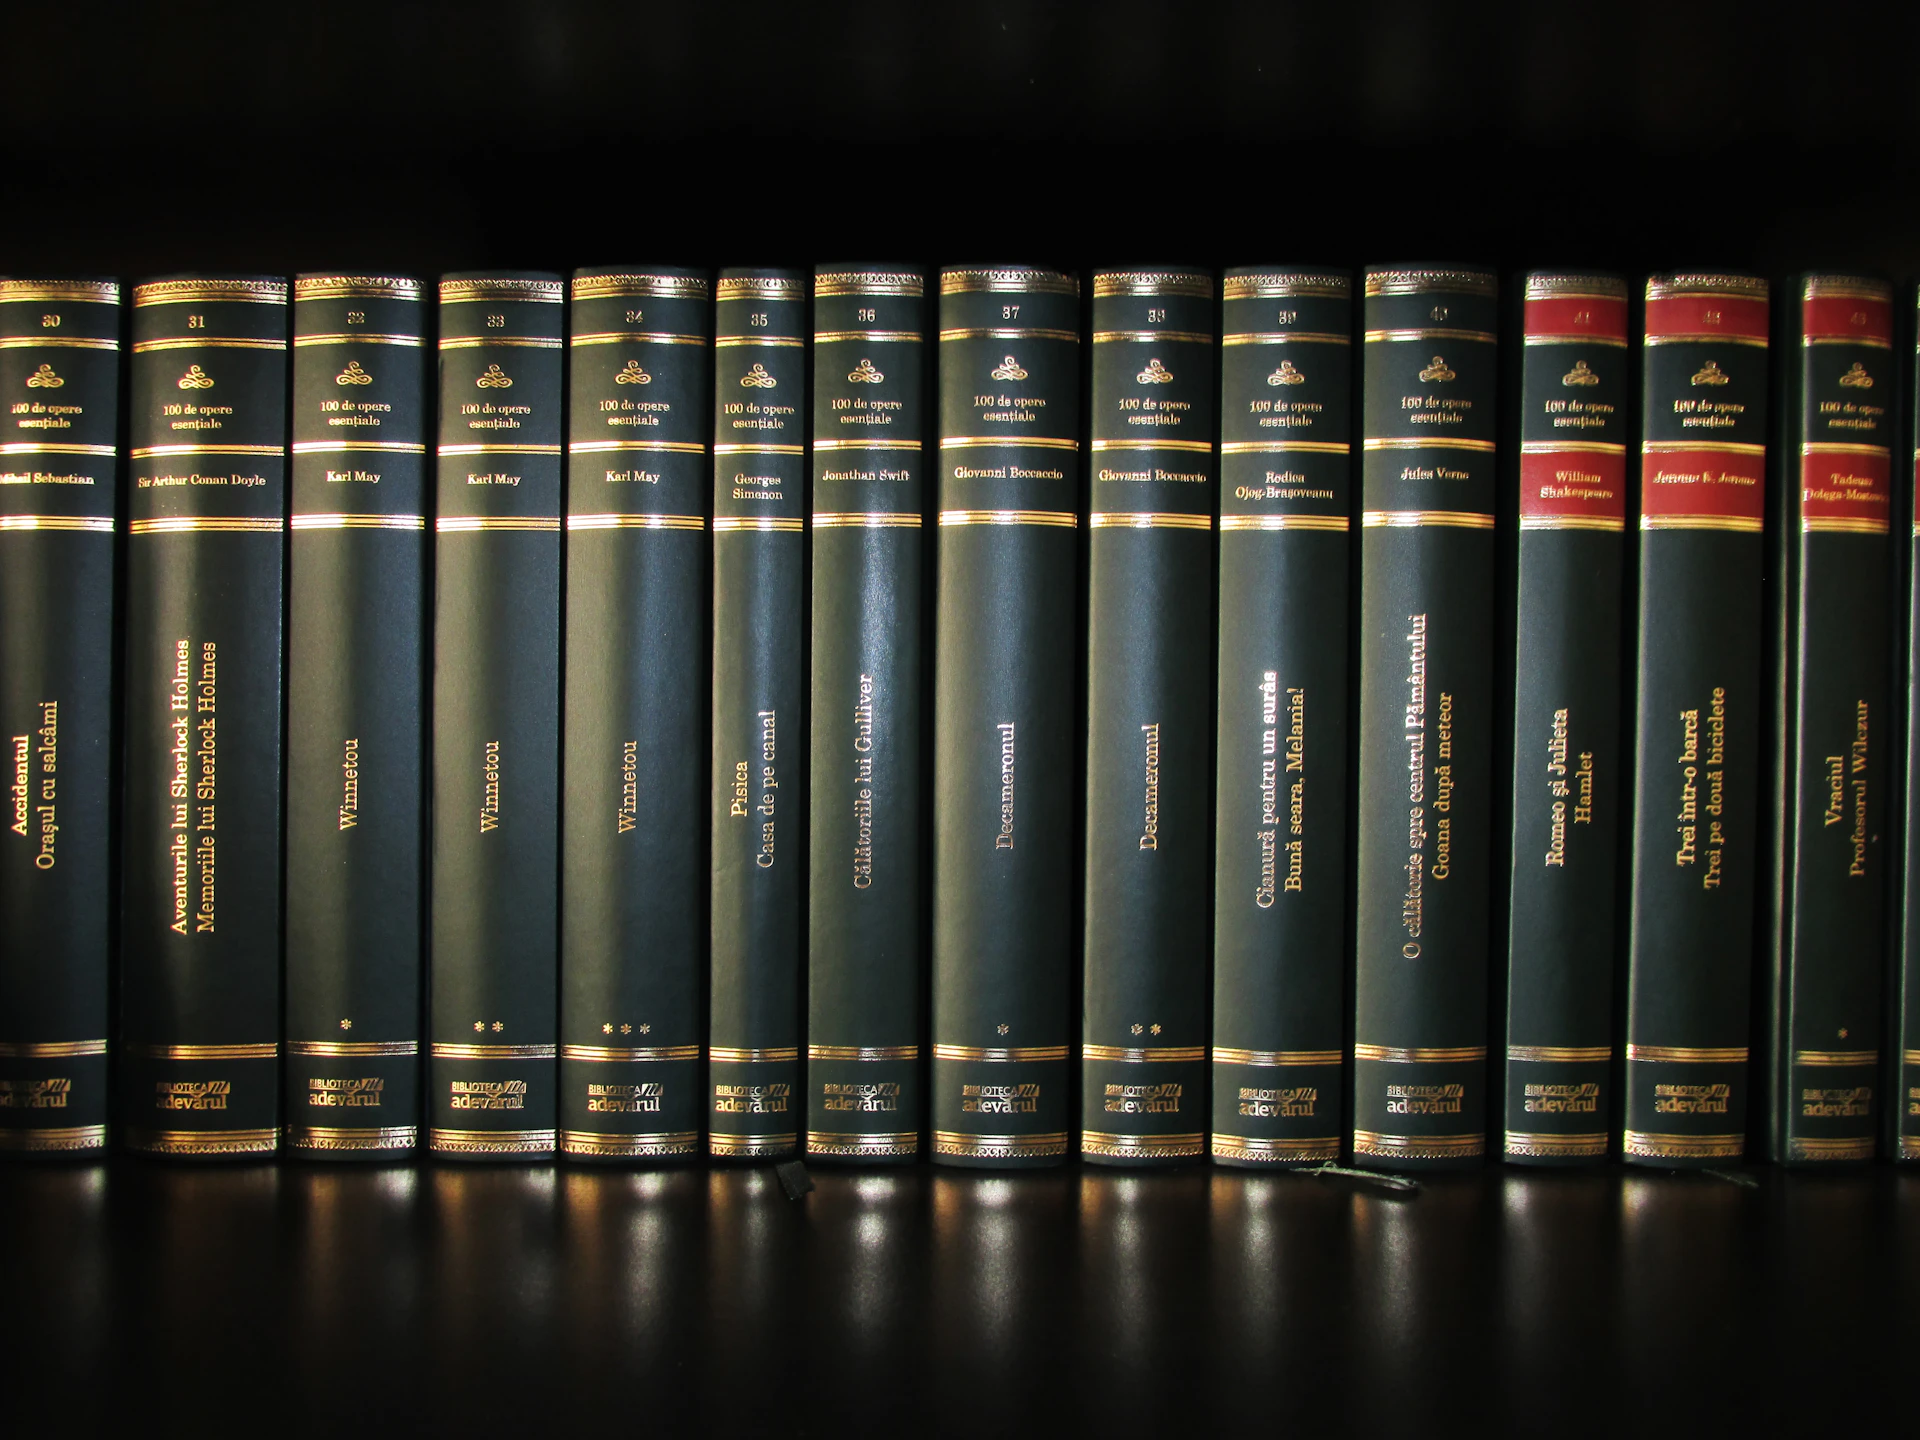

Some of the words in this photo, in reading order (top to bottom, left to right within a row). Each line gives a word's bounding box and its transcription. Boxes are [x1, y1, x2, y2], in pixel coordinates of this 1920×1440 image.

[42, 315, 60, 327] 30
[189, 316, 204, 328] 31
[626, 310, 643, 323] 34
[751, 314, 767, 326] 35
[859, 309, 875, 322] 36
[1003, 306, 1019, 319] 37
[10, 403, 29, 413] 100
[31, 402, 46, 413] de
[48, 406, 82, 416] opere
[163, 404, 182, 415] 100
[184, 404, 197, 414] de
[200, 407, 232, 417] opere
[320, 400, 339, 411] 100
[341, 400, 355, 410] de
[358, 404, 391, 414] opere
[462, 404, 479, 414] 100
[482, 403, 497, 414] de
[498, 406, 530, 416] opere
[600, 400, 618, 411] 100
[621, 400, 635, 411] de
[637, 403, 670, 413] opere
[725, 403, 743, 414] 100
[747, 403, 760, 413] de
[763, 406, 794, 416] opere
[833, 399, 850, 409] 100
[854, 398, 867, 408] de
[871, 401, 902, 411] opere
[974, 396, 994, 406] 100
[998, 395, 1011, 406] de
[1014, 398, 1046, 408] opere
[1119, 399, 1139, 410] 100
[1143, 398, 1156, 409] de
[1160, 402, 1190, 412] opere
[32, 472, 94, 484] Sebastian
[138, 477, 151, 488] Sir
[152, 475, 187, 486] Arthur
[190, 474, 228, 484] Conan
[231, 474, 266, 487] Doyle
[326, 471, 351, 481] Karl
[354, 471, 380, 483] May
[467, 474, 492, 484] Karl
[494, 474, 521, 486] May
[606, 471, 630, 481] Karl
[634, 471, 660, 484] May
[733, 488, 782, 499] Simenon
[735, 474, 781, 487] Georges
[823, 469, 875, 480] Jonathan
[880, 469, 910, 481] Swift
[954, 466, 1006, 478] Giovanni
[1010, 466, 1063, 480] Boccaccio
[1099, 469, 1151, 481] Giovanni
[1155, 469, 1206, 482] Boccaccio
[170, 640, 188, 710] Holmes
[198, 642, 216, 712] Holmes
[1405, 614, 1426, 728] Pământului
[855, 674, 872, 752] Gulliver
[1259, 670, 1277, 724] surâs
[38, 701, 57, 772] salcâmi
[758, 709, 775, 760] canal
[1263, 728, 1276, 755] un
[1286, 688, 1304, 772] Melania!
[1438, 692, 1452, 759] meteor
[1548, 708, 1568, 775] Julieta
[1678, 710, 1698, 763] barcă
[1707, 687, 1725, 764] biciclete
[1852, 700, 1868, 773] Wilczur
[170, 716, 188, 798] Sherlock
[197, 718, 215, 799] Sherlock
[761, 764, 778, 788] pe
[855, 757, 871, 782] lui
[1405, 733, 1424, 802] centrul
[10, 735, 29, 836] Accidentul
[43, 779, 55, 800] cu
[339, 739, 358, 830] Winnetou
[480, 741, 499, 833] Winnetou
[618, 741, 636, 833] Winnetou
[731, 762, 747, 816] Pisica
[757, 794, 774, 815] de
[996, 722, 1014, 849] Decameronul
[1140, 723, 1159, 850] Decameronul
[1260, 759, 1279, 824] pentru
[1433, 765, 1454, 812] după
[1574, 752, 1592, 824] Hamlet
[1678, 767, 1697, 822] într-o
[1706, 771, 1723, 815] două
[1825, 756, 1843, 826] Vraciul
[170, 803, 187, 828] lui
[197, 805, 215, 830] lui
[1410, 807, 1427, 848] spre
[1545, 802, 1565, 867] Romeo
[1710, 822, 1725, 845] pe
[1850, 780, 1866, 875] Profesorul
[757, 822, 774, 868] Casa
[854, 789, 871, 888] Călătoriile
[1432, 818, 1450, 879] Goana
[1677, 826, 1696, 866] Trei
[170, 834, 187, 935] Aventurile
[197, 837, 215, 932] Memoriile
[1256, 829, 1275, 908] Cianură
[1284, 841, 1302, 892] Bună
[1704, 849, 1721, 888] Trei
[1403, 853, 1422, 937] călătorie
[1403, 943, 1421, 958] O
